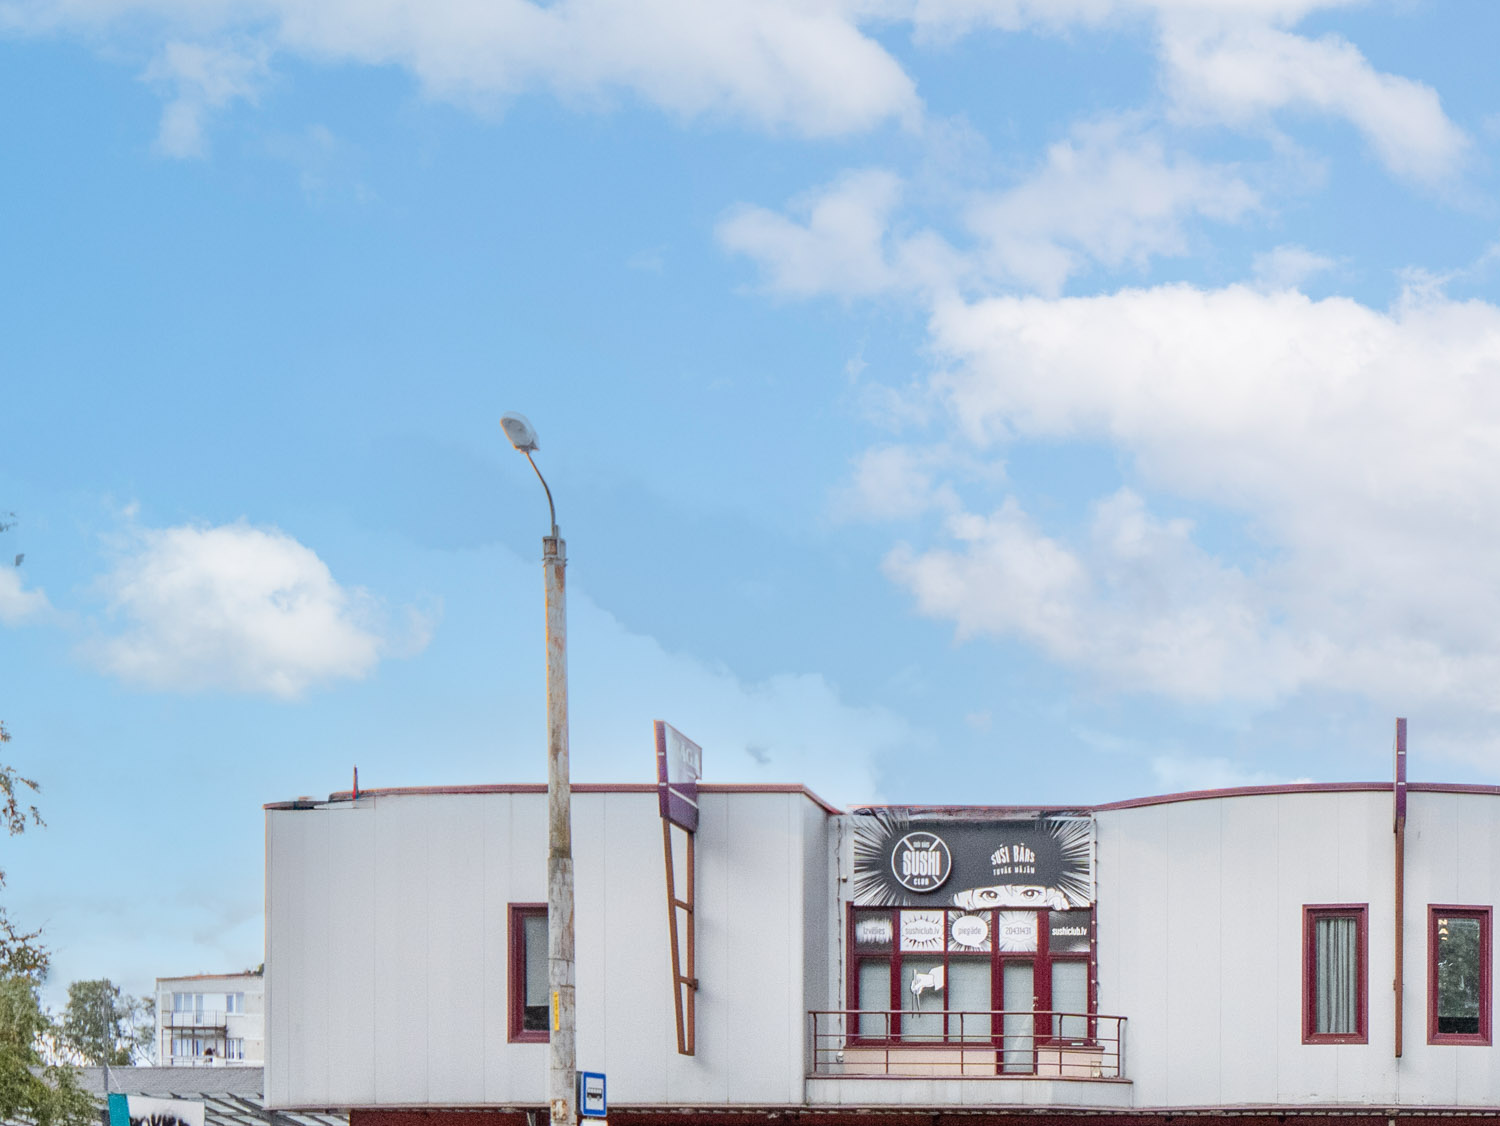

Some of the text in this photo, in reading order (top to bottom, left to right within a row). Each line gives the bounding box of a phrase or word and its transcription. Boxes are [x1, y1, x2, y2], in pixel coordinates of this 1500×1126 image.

[903, 850, 940, 876] SUSHI
[905, 926, 940, 935] sushiclub.lv
[1052, 927, 1088, 936] sushiclub.lv
